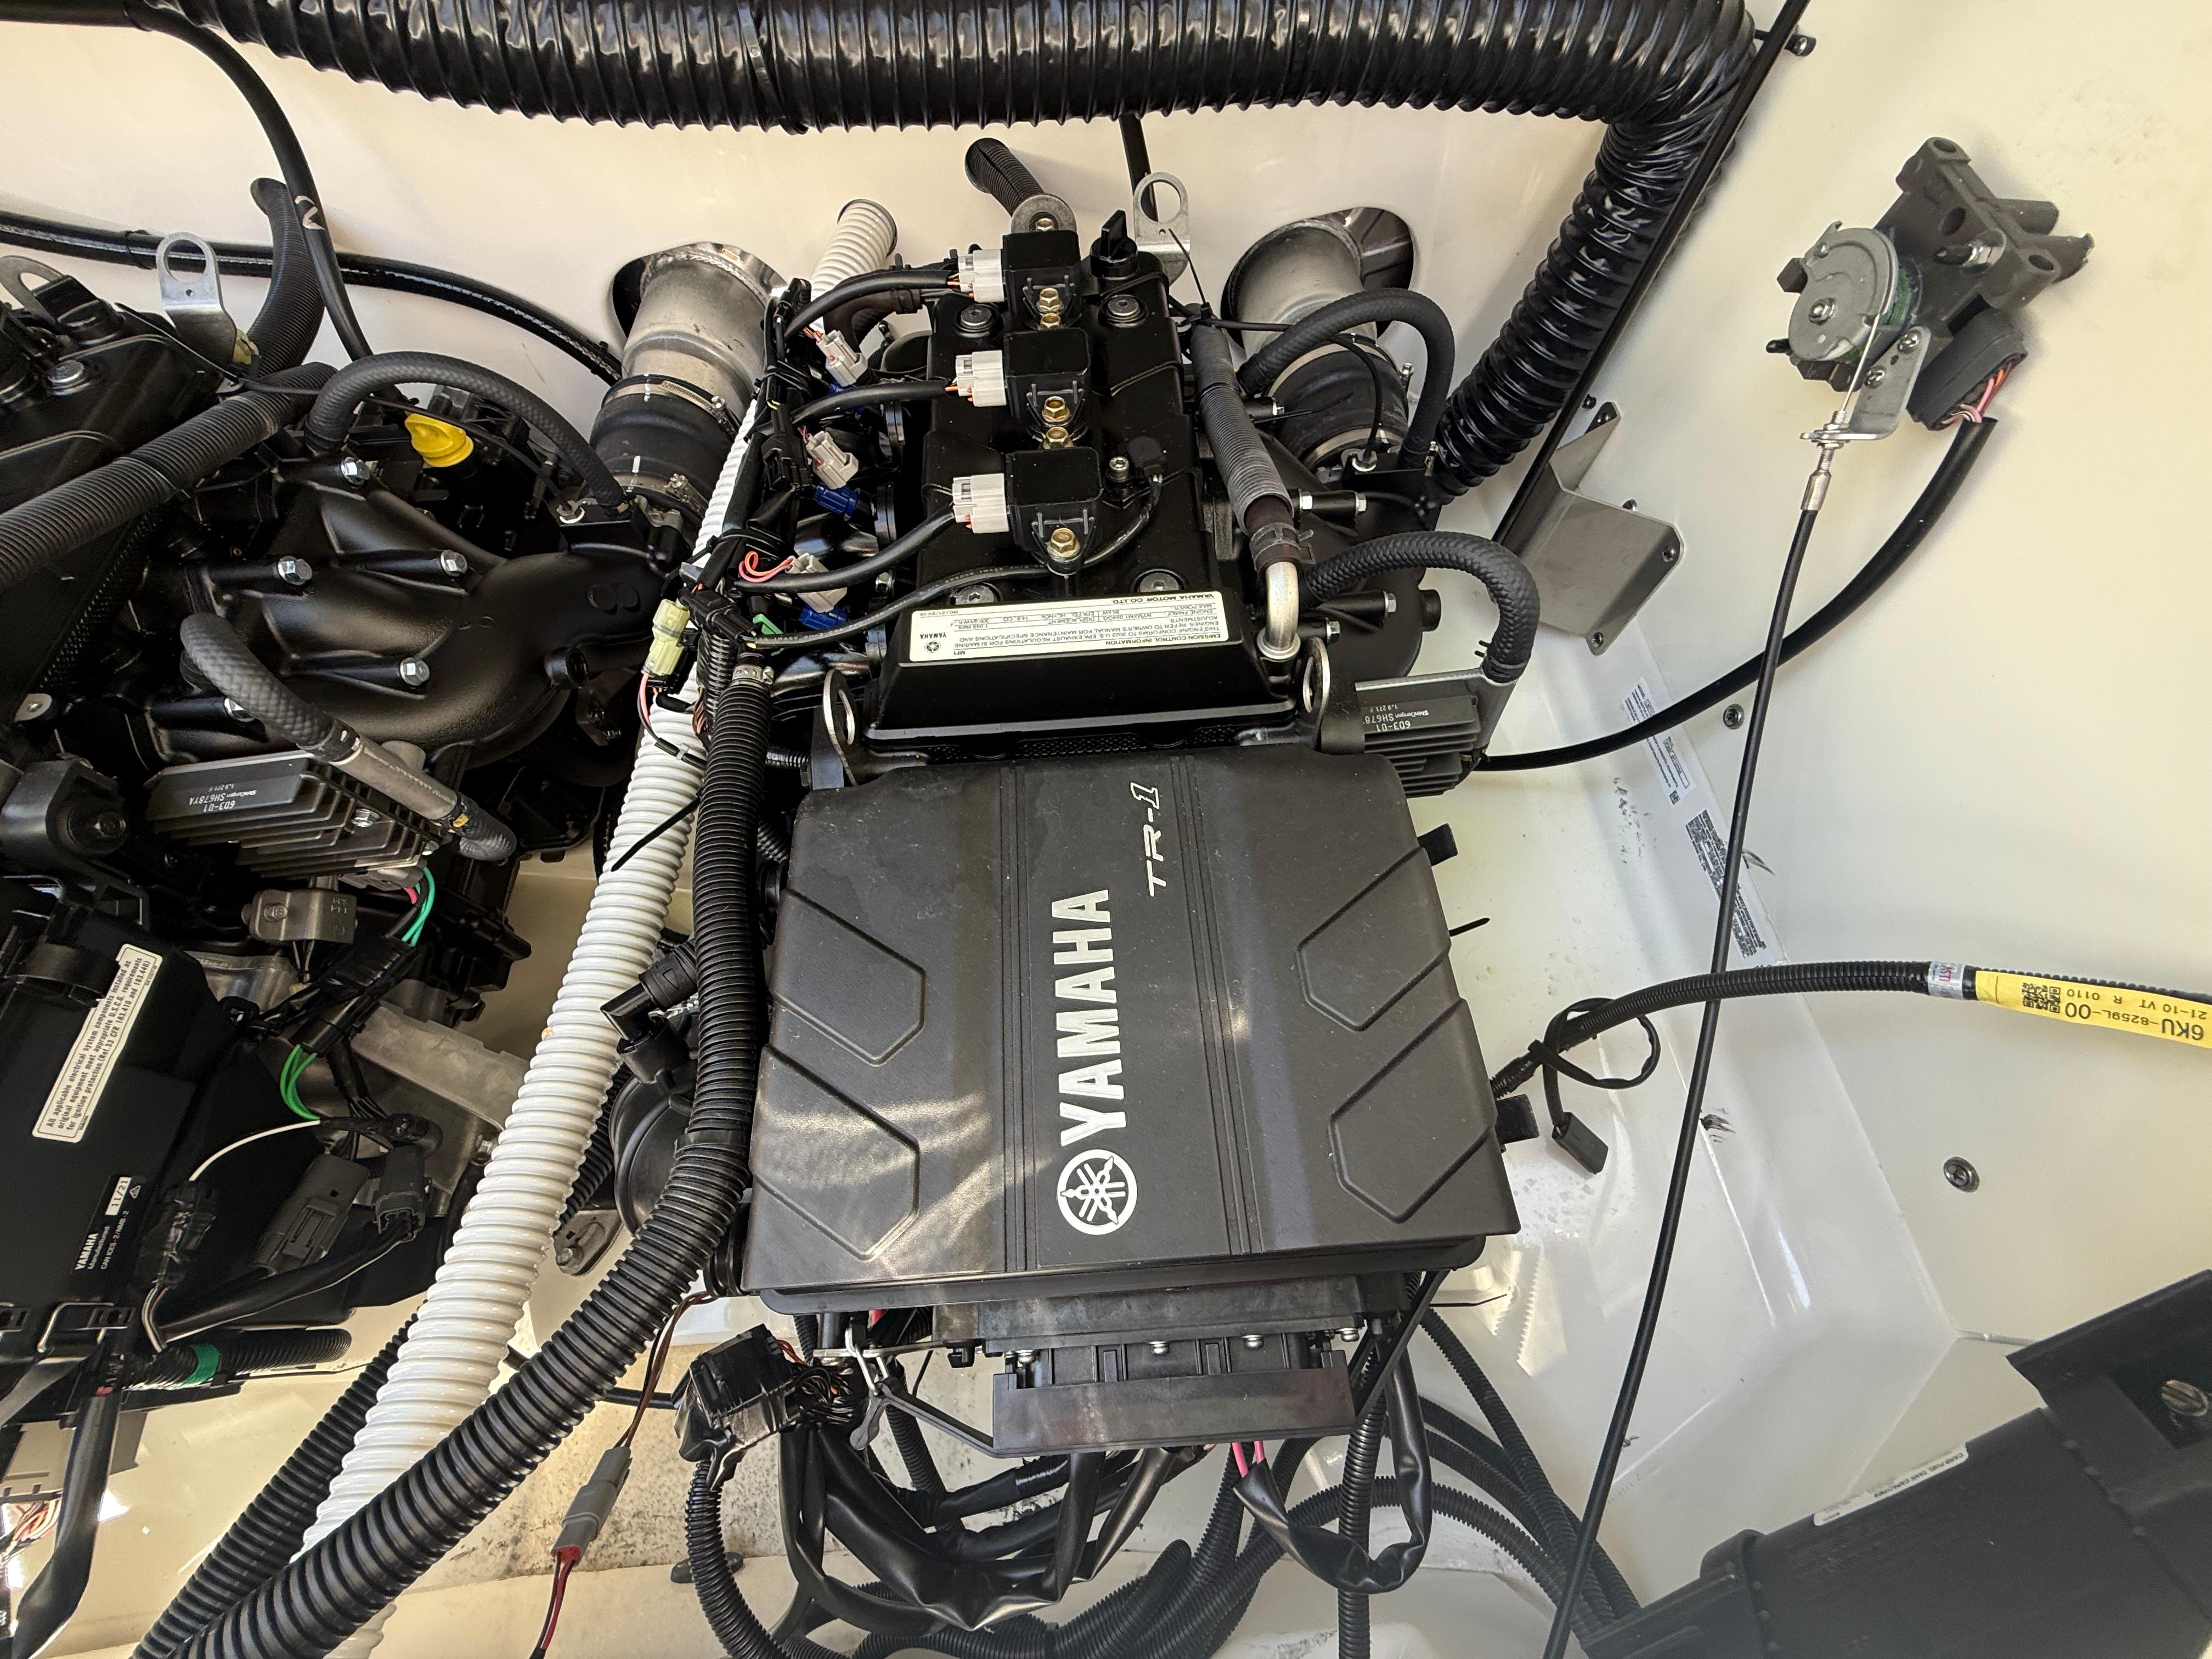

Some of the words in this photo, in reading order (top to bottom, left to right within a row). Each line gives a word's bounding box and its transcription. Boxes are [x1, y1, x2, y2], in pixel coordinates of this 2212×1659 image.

[975, 633, 1028, 641] SPECIFICATIONS
[1376, 720, 1411, 733] 6D3-01
[188, 792, 227, 805] SH678YA
[202, 800, 236, 812] 6D3-01
[1130, 782, 1166, 896] TR-1
[2066, 989, 2101, 1001] 0110
[2113, 995, 2122, 1004] R
[2139, 999, 2157, 1010] VT
[1052, 889, 1126, 1146] YAMAHA
[2064, 1002, 2205, 1041] 6KU-8259L-00
[2162, 1004, 2208, 1020] 21-10
[45, 1116, 57, 1128] All
[51, 1083, 74, 1116] applicable
[66, 1052, 87, 1083] electrical
[83, 1029, 100, 1053] system
[93, 994, 116, 1029] components
[110, 968, 127, 994] installed
[123, 960, 131, 968] as
[55, 1104, 74, 1130] original
[68, 1070, 90, 1104] equipment
[83, 1053, 97, 1070] meet
[92, 1018, 115, 1053] appropriate
[120, 956, 144, 994] requirements
[66, 1120, 76, 1132] for
[71, 1094, 89, 1120] ignition
[109, 1025, 120, 1038] CFR
[115, 999, 132, 1024] 183.410
[128, 988, 138, 999] and
[111, 1178, 129, 1207] 11/21
[75, 1232, 99, 1272] YAMAHA
